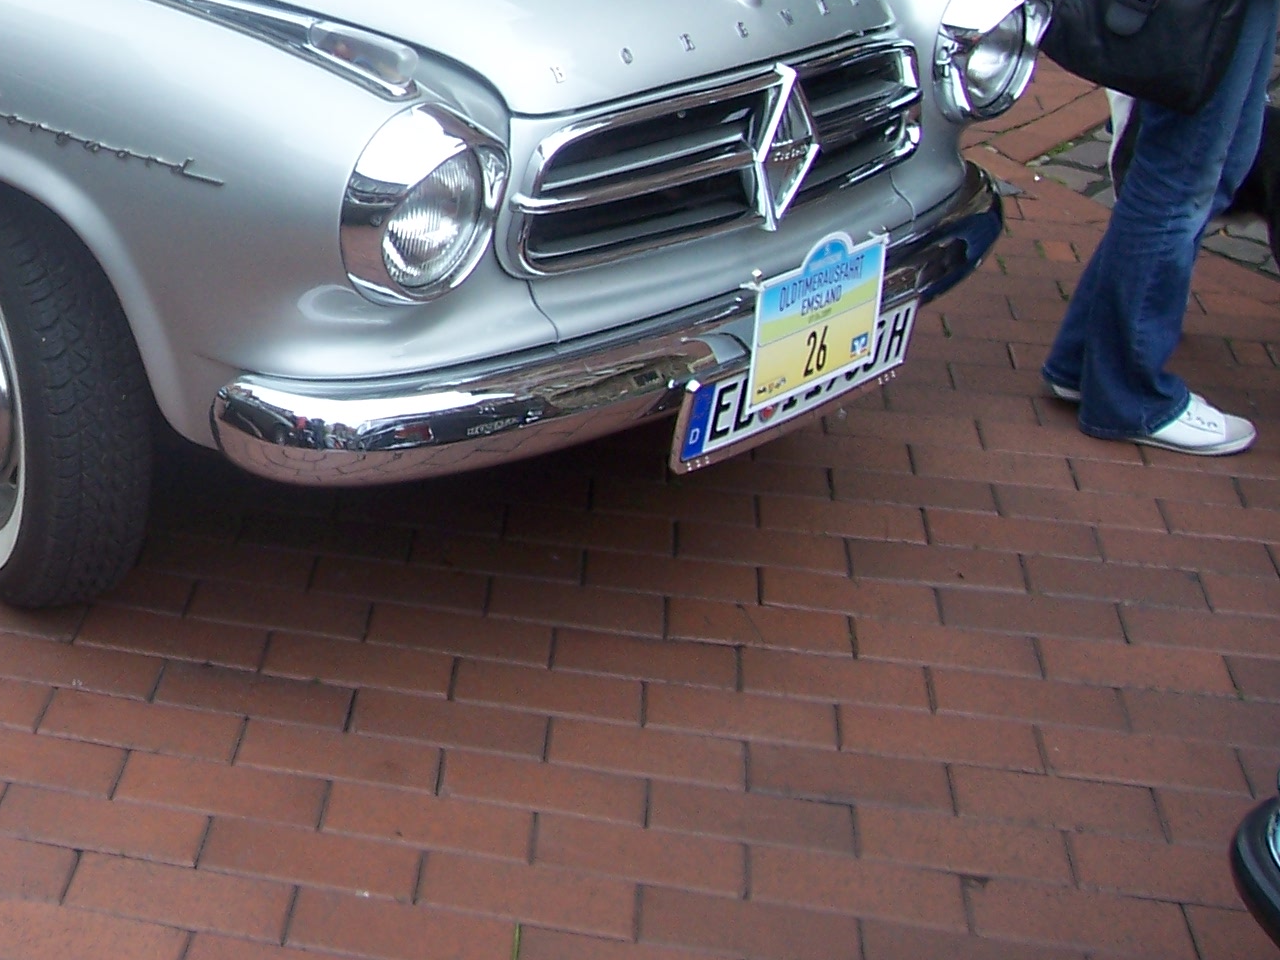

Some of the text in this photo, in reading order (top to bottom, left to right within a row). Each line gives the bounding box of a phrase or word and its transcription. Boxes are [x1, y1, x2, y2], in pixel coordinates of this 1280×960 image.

[779, 255, 865, 312] OLDTIMERAUSFAHRT
[801, 285, 842, 316] EMSLAND
[803, 325, 829, 378] 26
[689, 427, 701, 445] D
